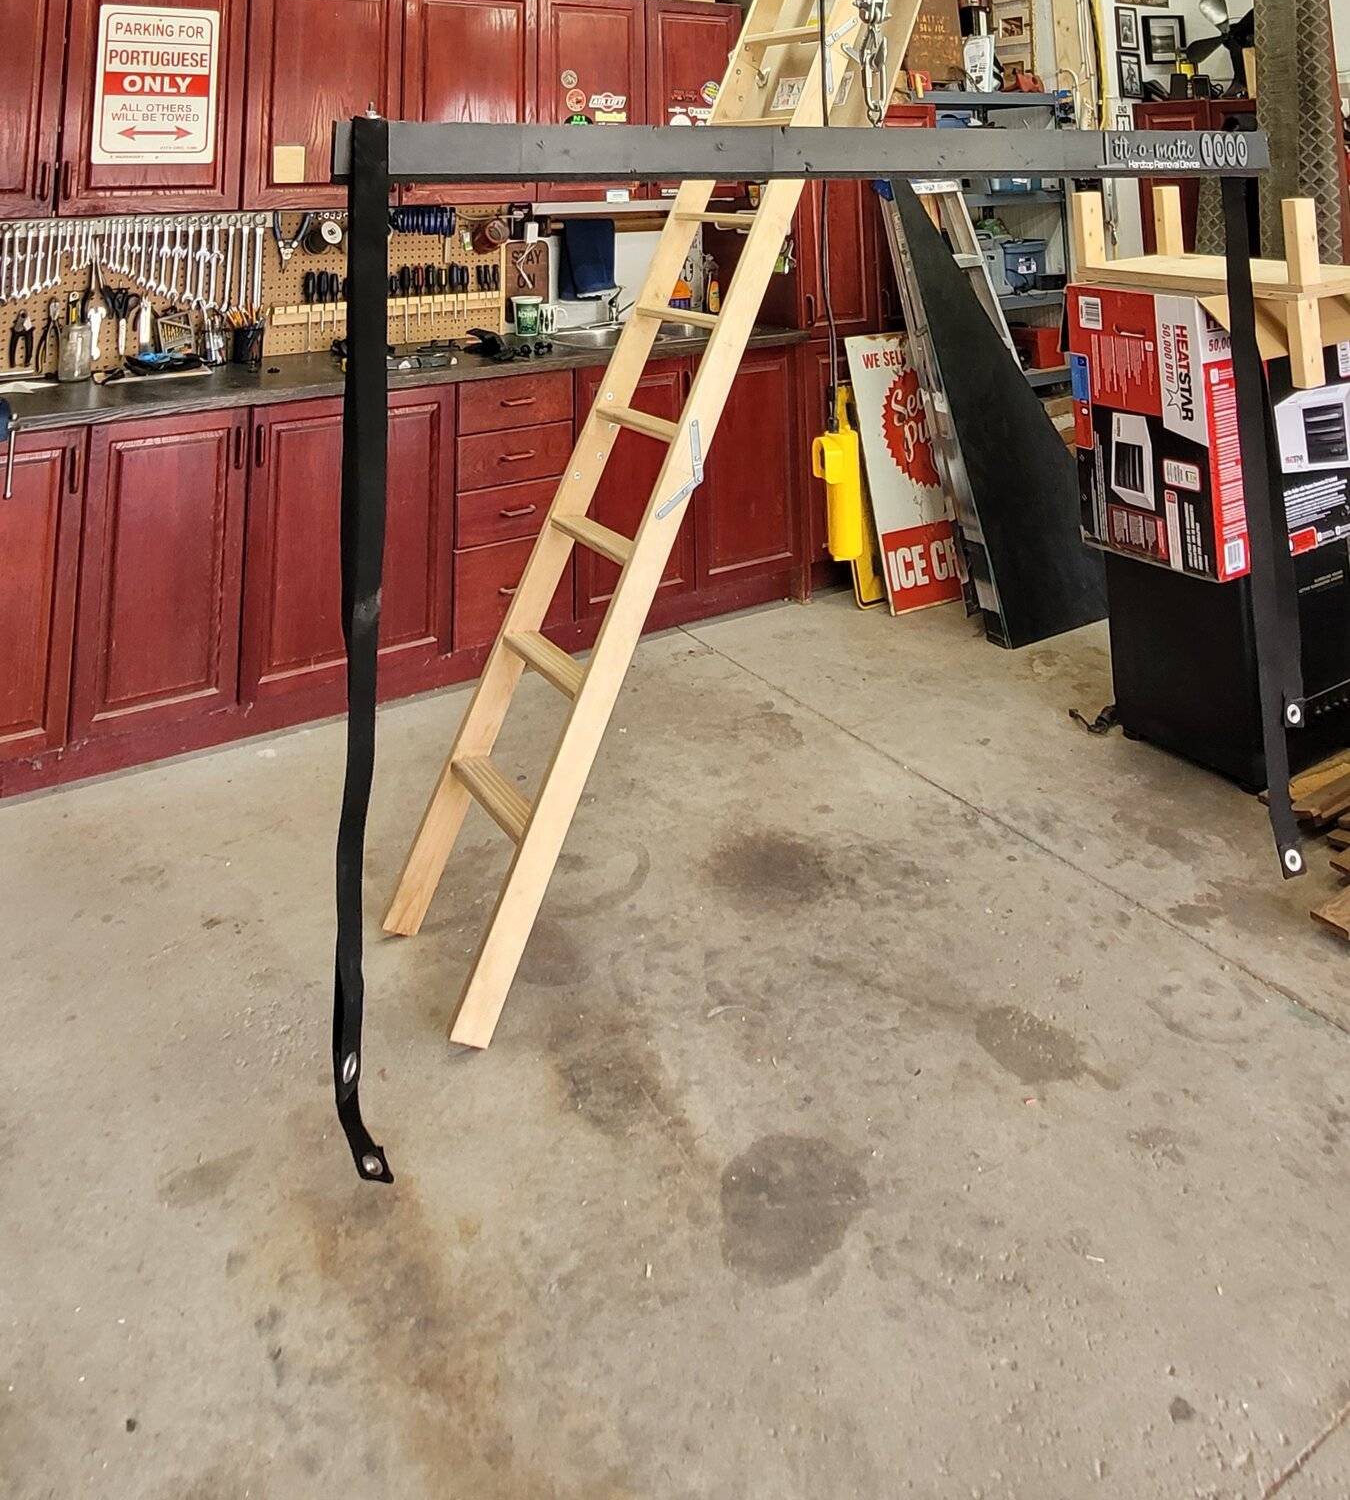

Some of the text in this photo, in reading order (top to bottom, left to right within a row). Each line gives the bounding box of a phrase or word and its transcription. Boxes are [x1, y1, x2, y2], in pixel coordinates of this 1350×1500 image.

[115, 22, 204, 39] PARKING FOR
[108, 49, 208, 68] PORTUGUESE
[122, 75, 192, 94] ONLY
[111, 112, 199, 122] WILL BE TOWED
[120, 103, 192, 113] ALL OTHERS
[1203, 136, 1247, 164] 1000
[862, 353, 881, 369] WE
[1161, 323, 1175, 384] 50,000 BTU
[1174, 324, 1195, 422] HEATSTAR
[888, 544, 930, 592] ICE
